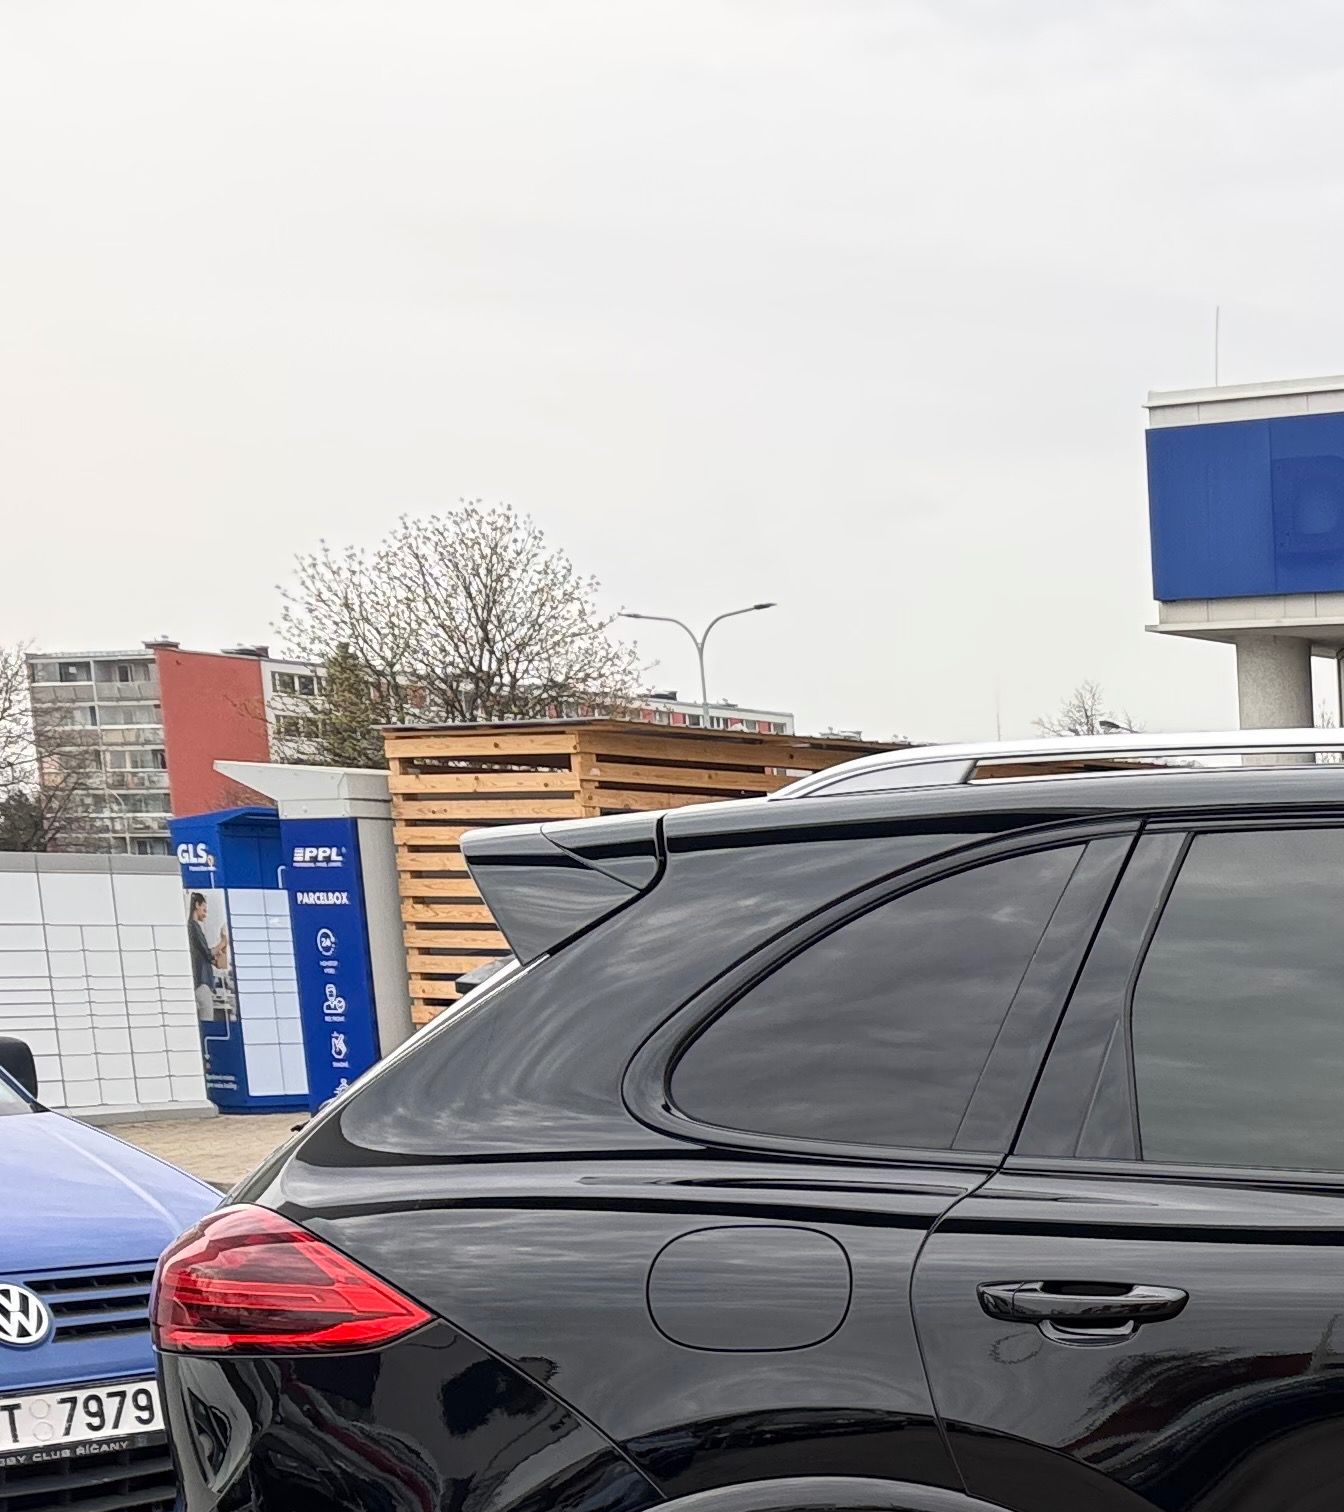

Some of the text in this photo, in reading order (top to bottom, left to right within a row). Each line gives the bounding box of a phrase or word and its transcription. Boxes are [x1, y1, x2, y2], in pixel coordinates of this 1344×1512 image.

[177, 843, 208, 864] GLS
[303, 847, 344, 861] PPL
[296, 891, 349, 905] PARCELBOX
[57, 1388, 156, 1437] 7979
[32, 1449, 71, 1462] CLUB
